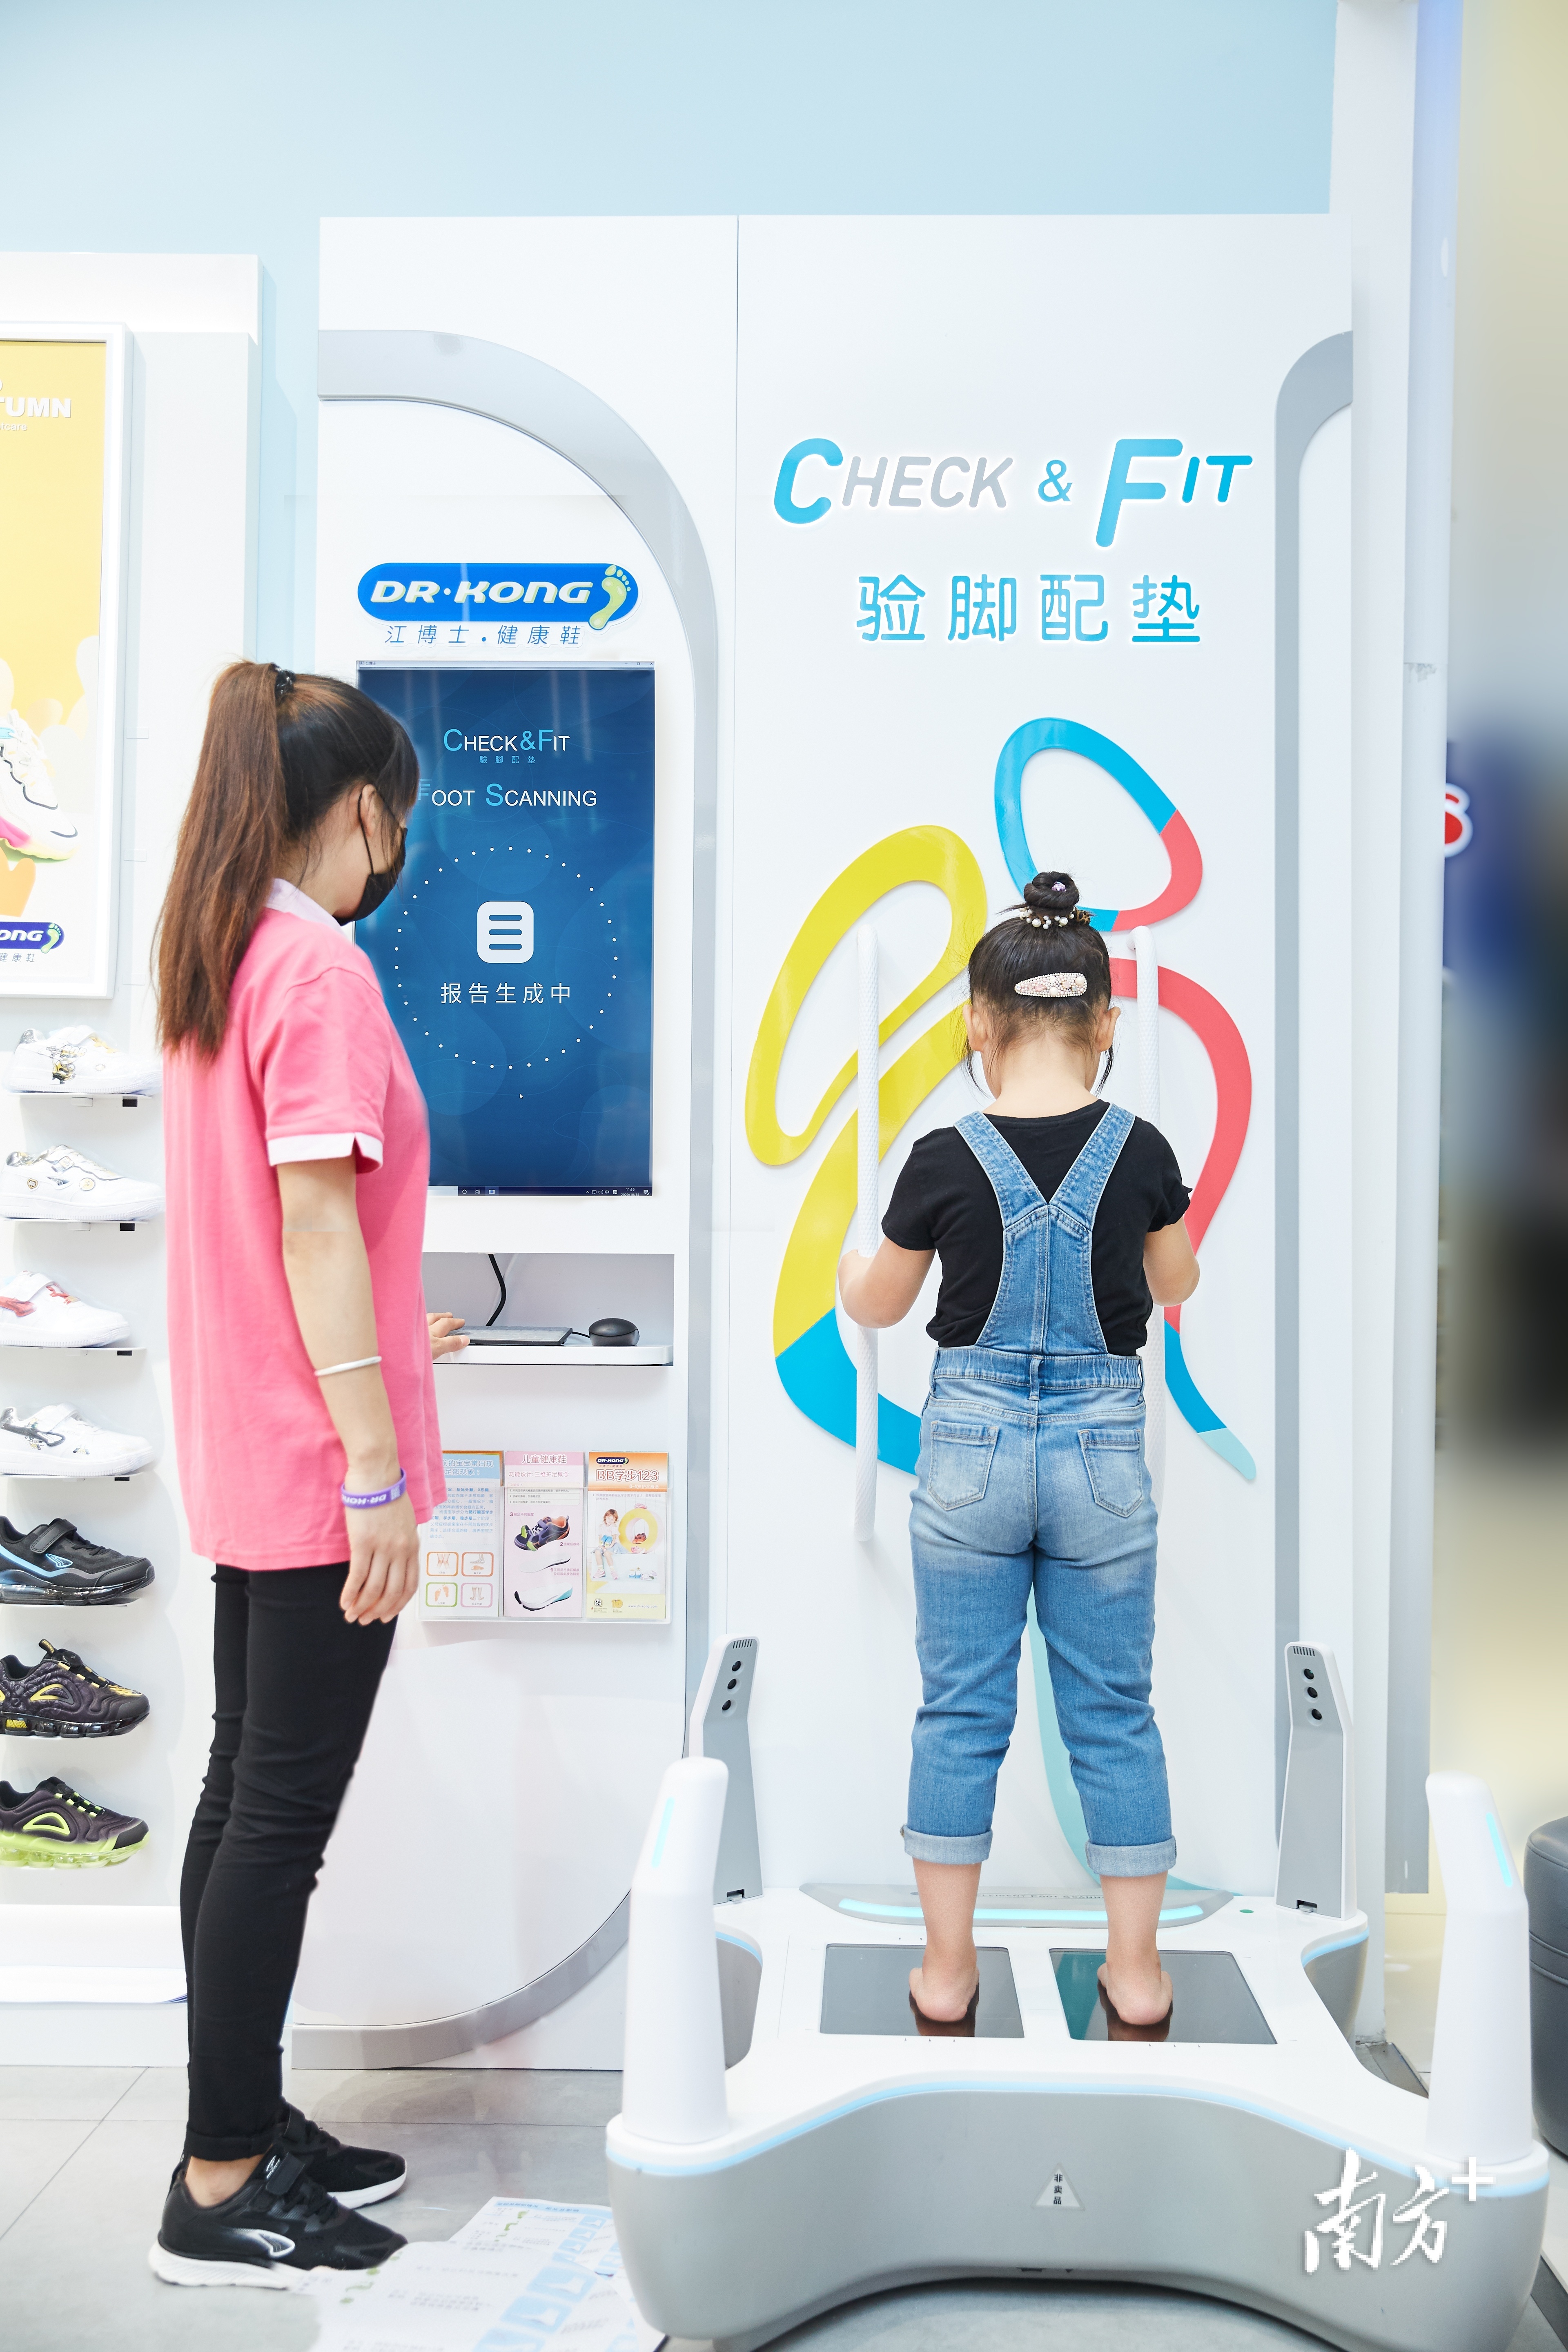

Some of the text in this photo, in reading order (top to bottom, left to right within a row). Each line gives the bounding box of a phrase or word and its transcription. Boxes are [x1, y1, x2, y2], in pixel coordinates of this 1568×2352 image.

[0, 423, 27, 431] tcare
[774, 438, 1253, 548] CHECK & FIT
[856, 574, 1200, 642] 验脚配垫
[479, 755, 535, 764] 驗腳配墊
[486, 783, 597, 807] SCANNING
[0, 953, 36, 962] 健康鞋
[441, 982, 571, 1004] 报告生成中
[522, 1455, 566, 1463] 儿童健康鞋
[596, 1469, 659, 1482] BB学步123
[1054, 2174, 1063, 2205] 非卖品
